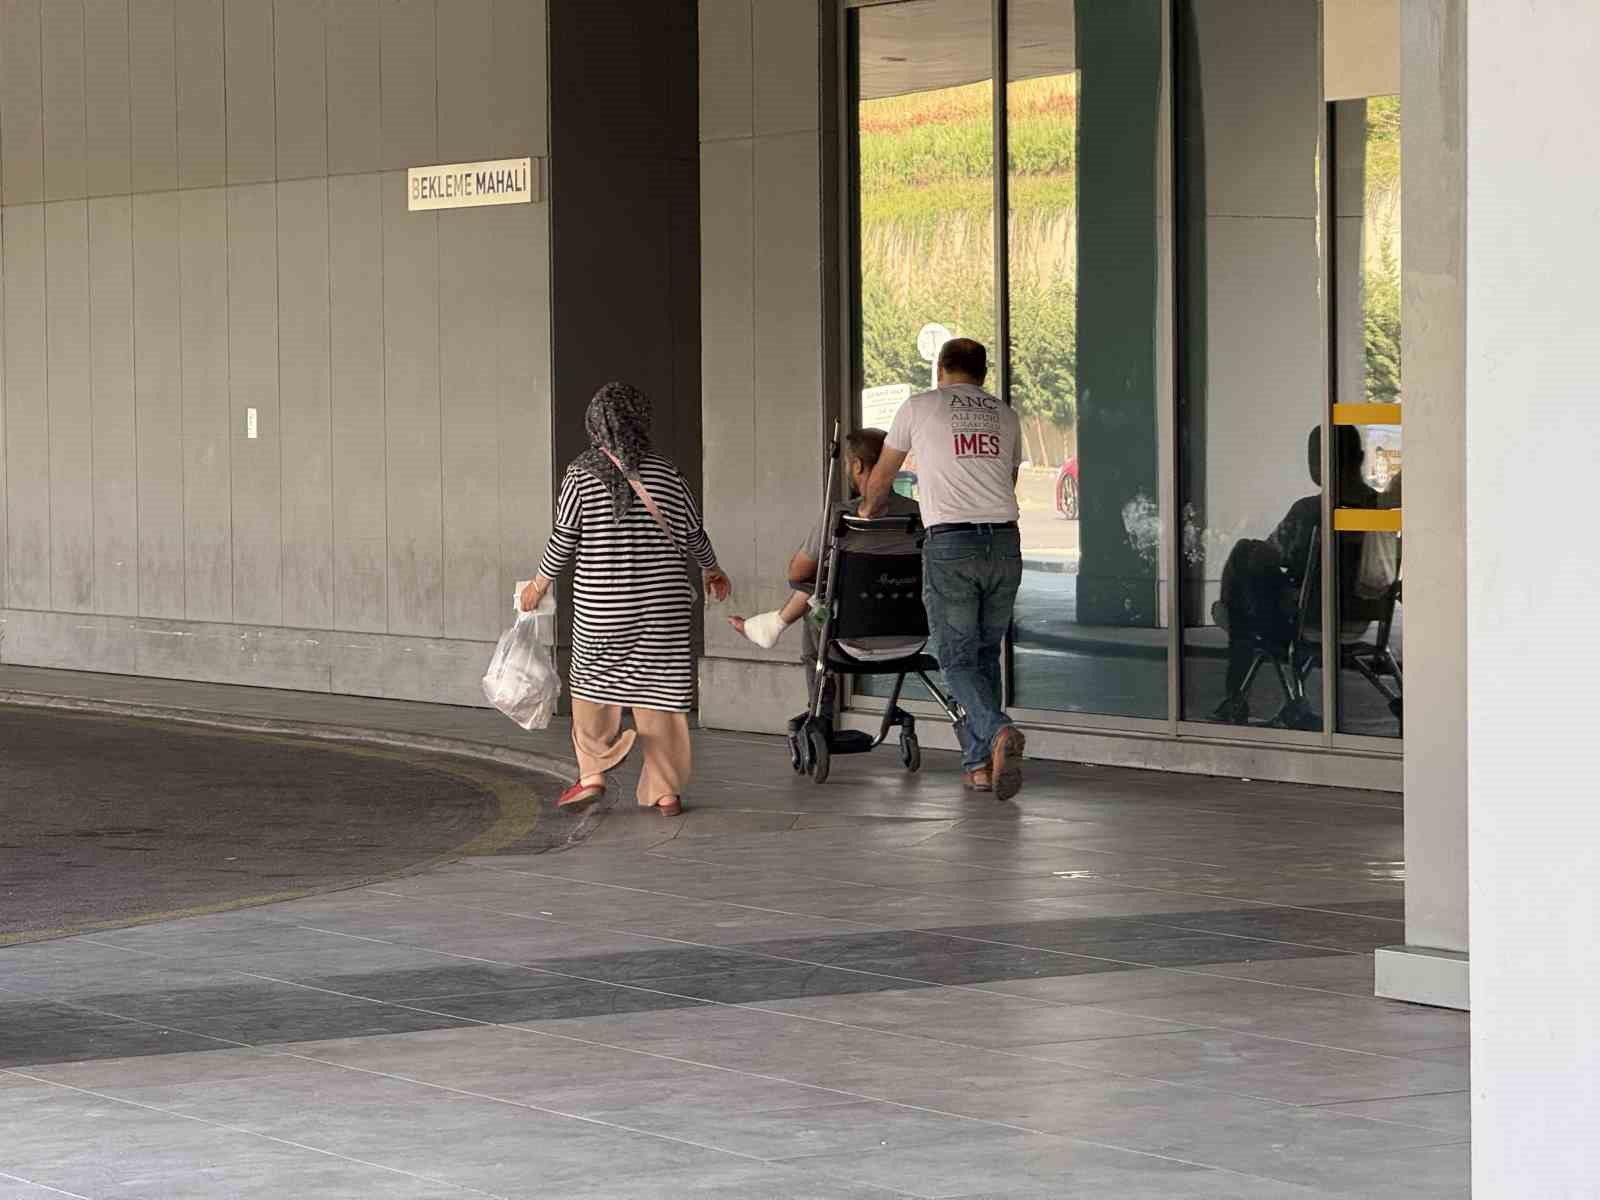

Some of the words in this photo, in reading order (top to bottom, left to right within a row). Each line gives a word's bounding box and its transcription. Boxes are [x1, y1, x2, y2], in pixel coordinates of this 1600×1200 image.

[412, 173, 472, 199] BEKLEME
[476, 161, 526, 195] MAHALİ
[949, 394, 998, 409] ANC
